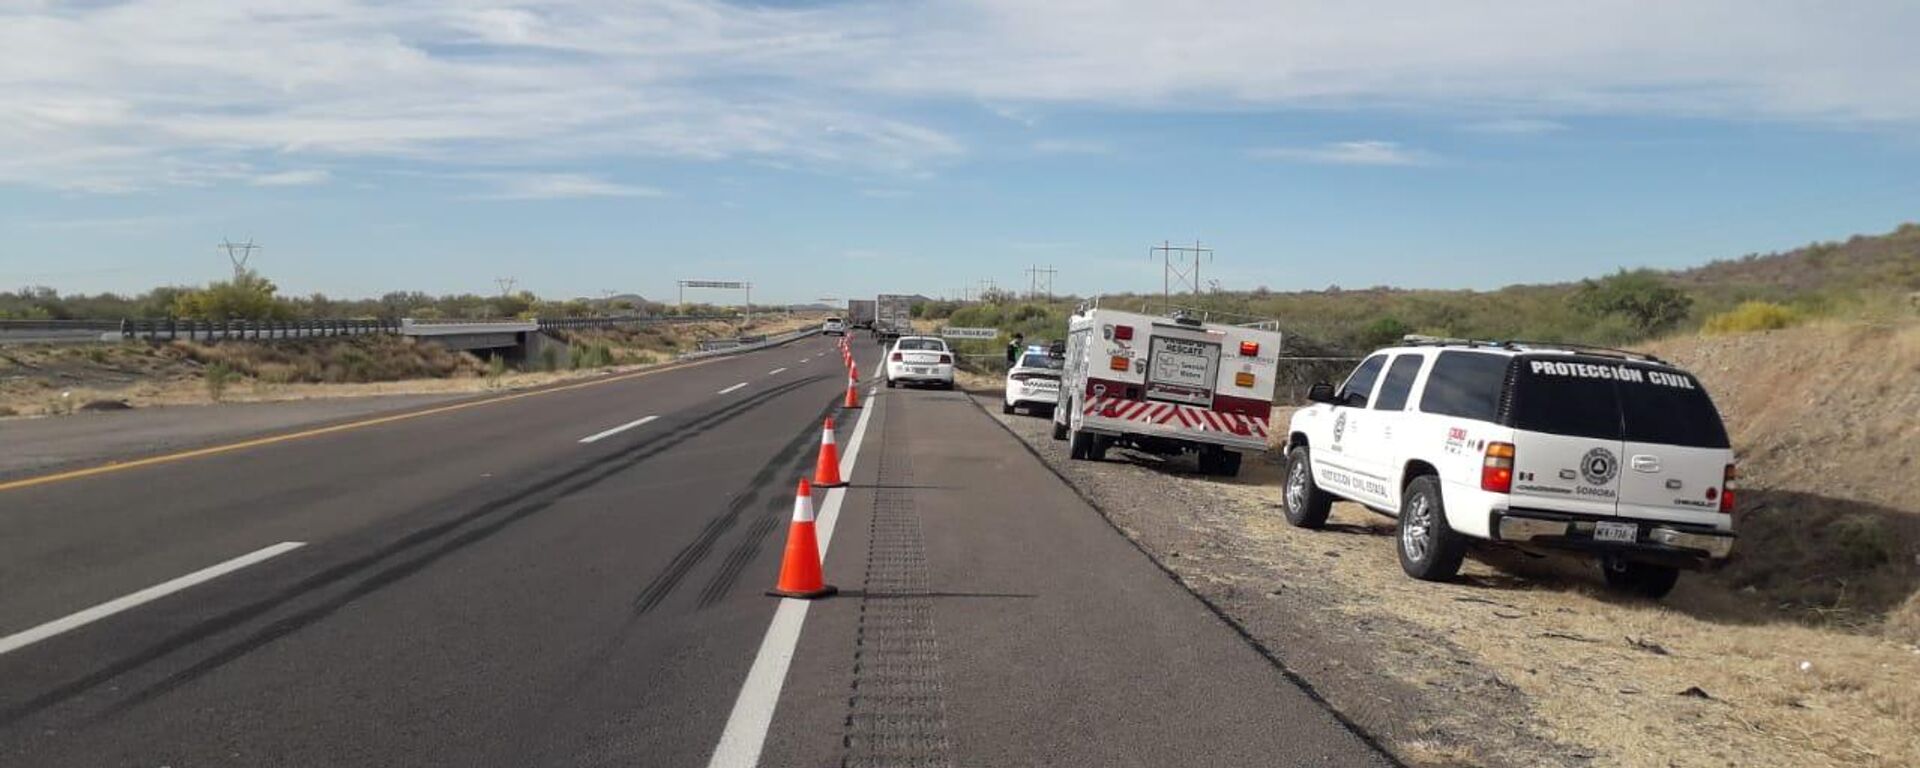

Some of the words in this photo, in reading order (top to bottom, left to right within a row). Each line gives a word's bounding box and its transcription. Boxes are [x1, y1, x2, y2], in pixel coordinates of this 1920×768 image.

[1530, 361, 1643, 383] PROTECCIÓN
[1648, 371, 1695, 389] CIVIL
[1576, 485, 1616, 497] SONORA
